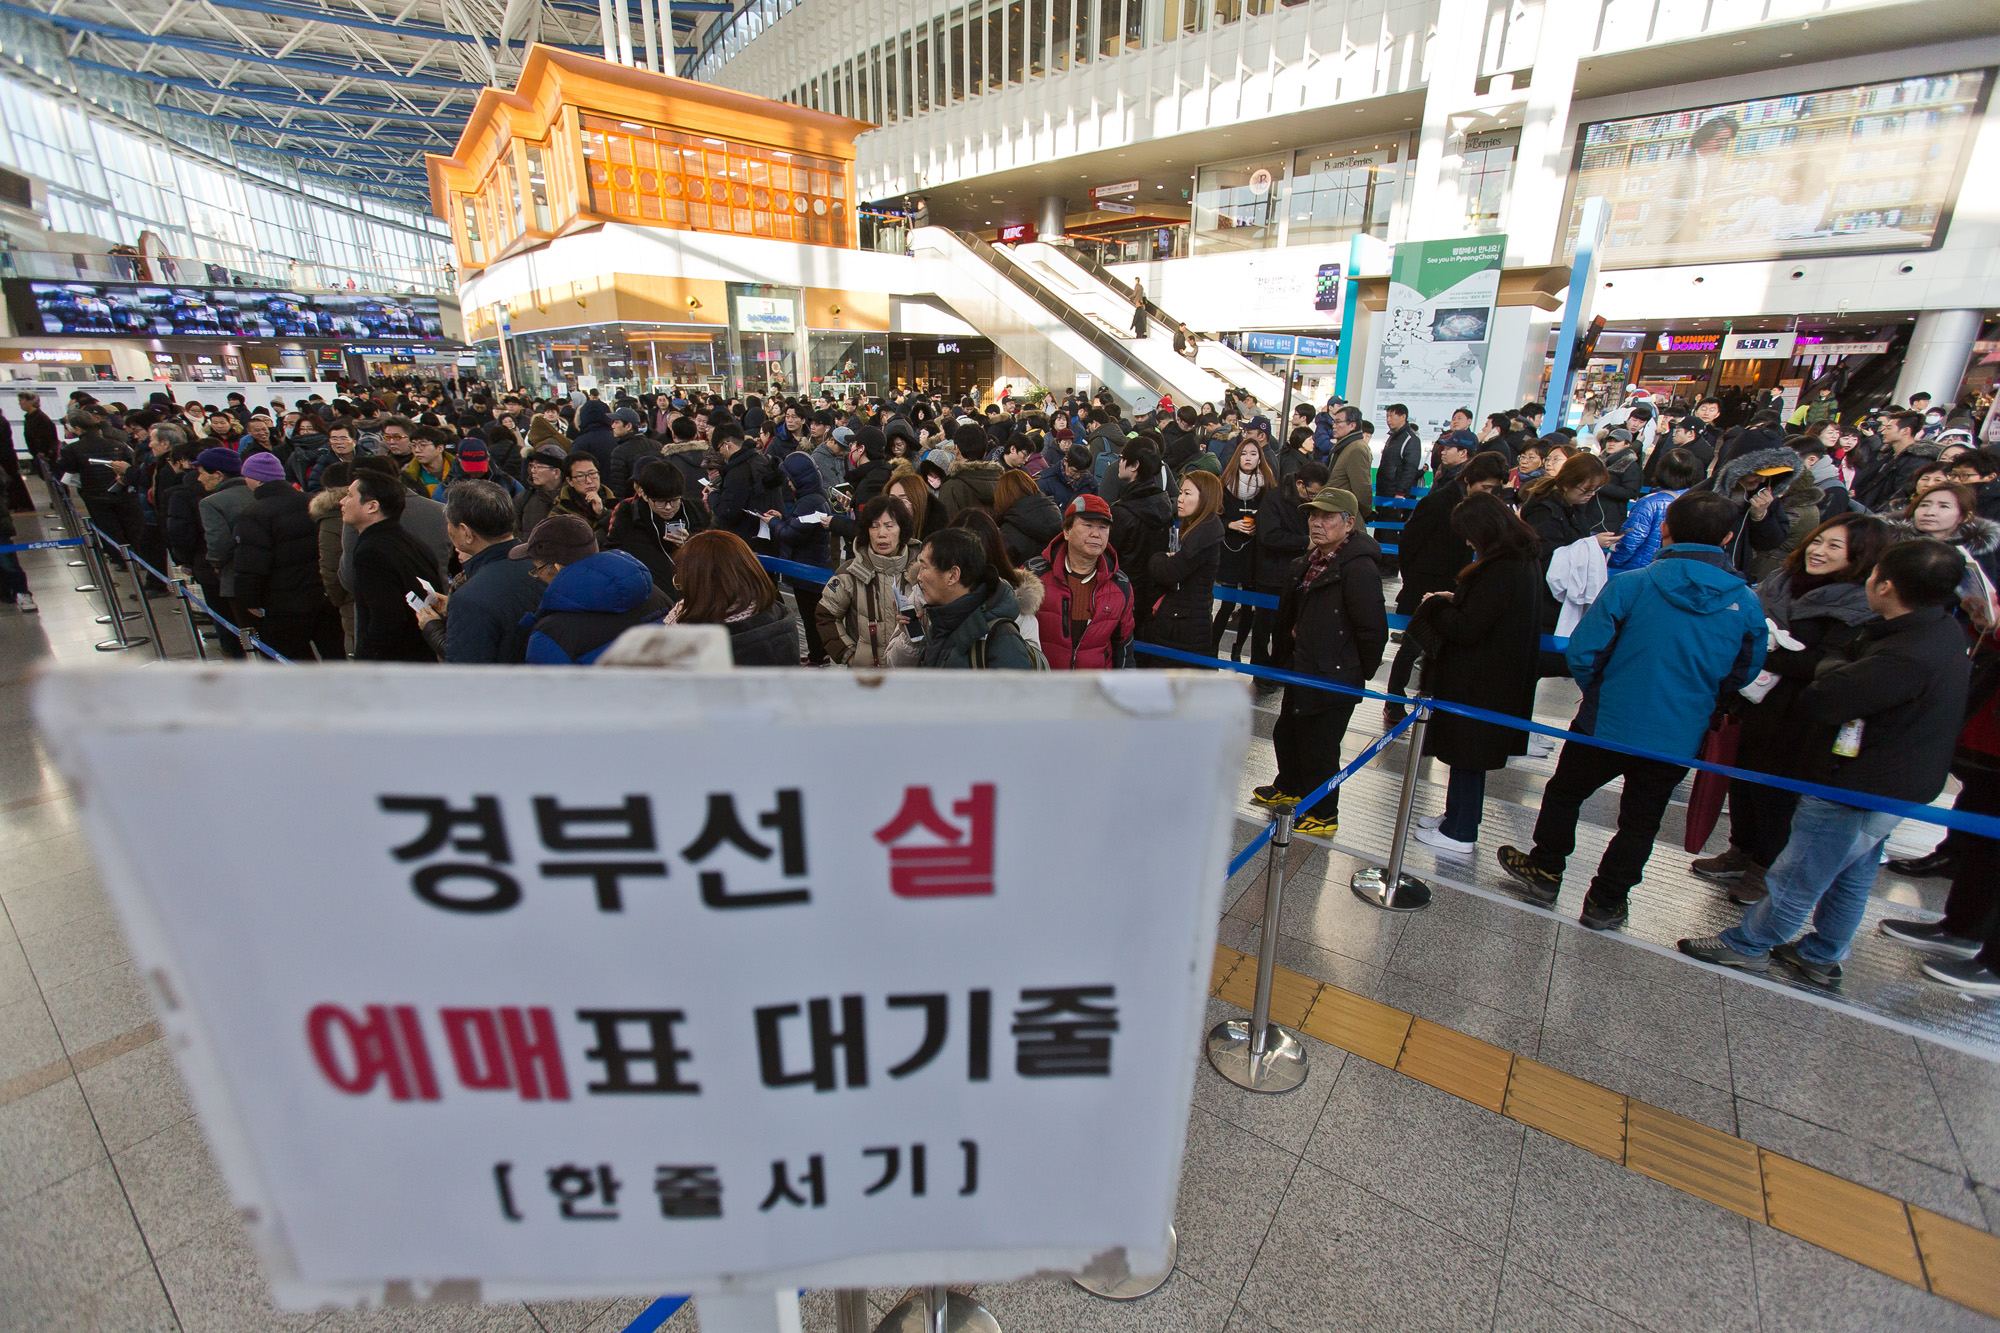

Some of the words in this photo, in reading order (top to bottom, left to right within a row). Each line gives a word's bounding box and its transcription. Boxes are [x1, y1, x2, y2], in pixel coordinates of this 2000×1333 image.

[1003, 226, 1025, 239] KFC
[1452, 246, 1477, 255] 평창에서
[1478, 244, 1500, 253] 만나요!
[1438, 256, 1449, 264] you
[1456, 253, 1499, 262] PyeongChang
[1671, 342, 1716, 351] DONUTS
[1327, 769, 1349, 791] KORAIL
[377, 788, 813, 916] 경부선
[874, 782, 998, 900] 설
[306, 1001, 703, 1102] 예매표
[753, 984, 1121, 1094] 대기줄
